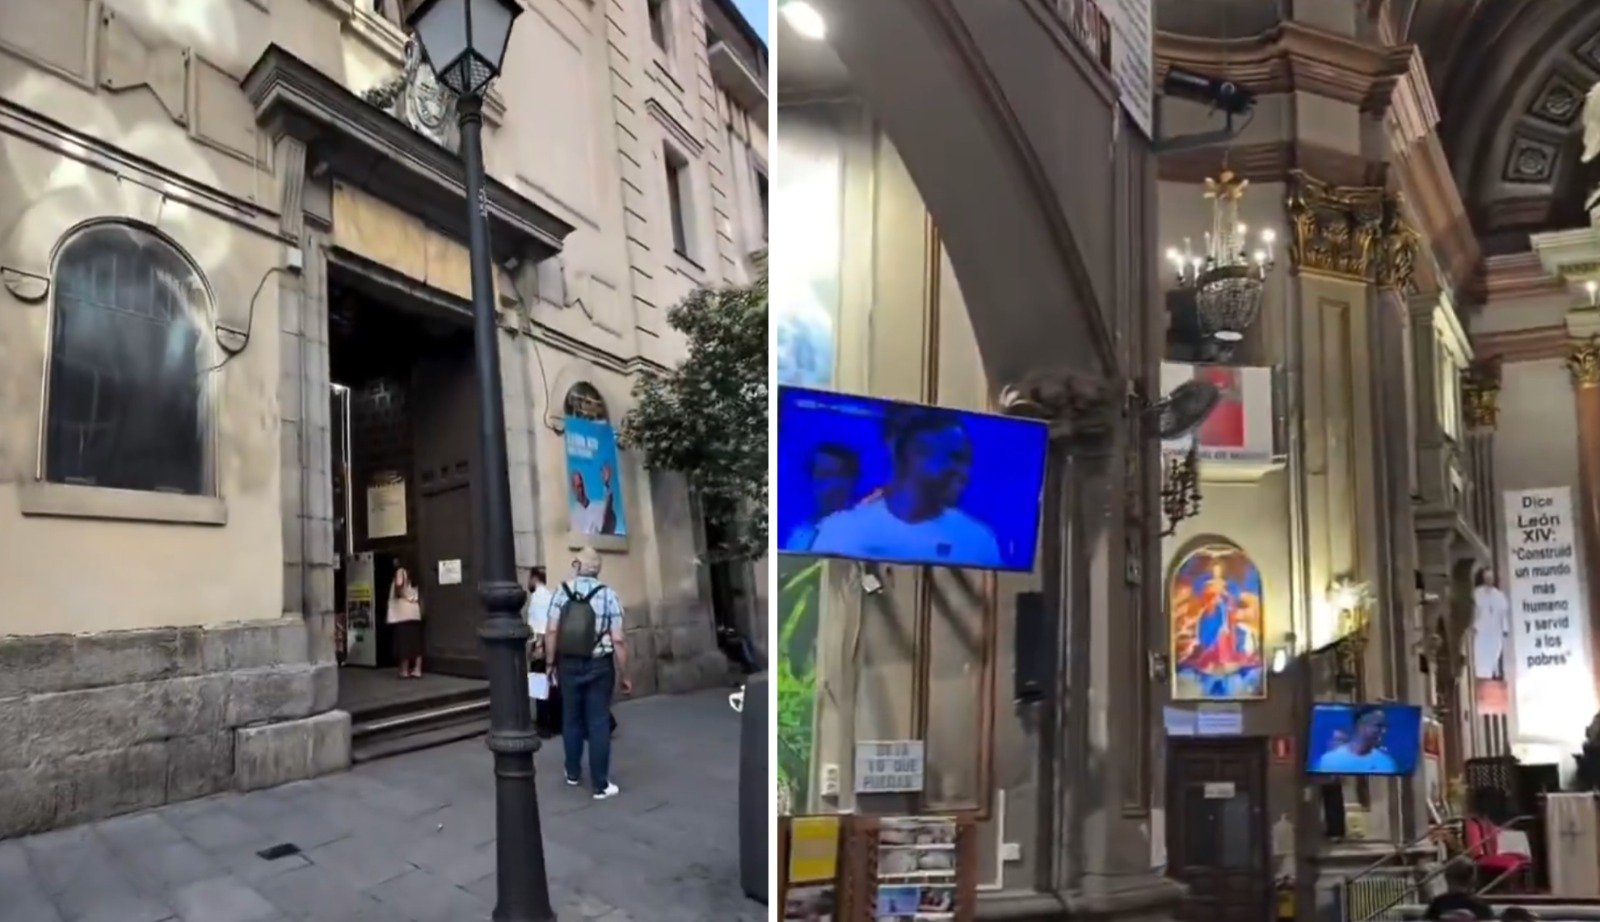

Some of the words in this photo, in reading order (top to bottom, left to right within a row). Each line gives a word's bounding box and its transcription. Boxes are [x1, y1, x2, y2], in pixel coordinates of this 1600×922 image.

[1522, 496, 1553, 508] Dice
[1518, 513, 1560, 529] León
[1523, 529, 1556, 542] XIV:
[1515, 566, 1530, 578] un
[1532, 564, 1571, 577] mundo
[1522, 599, 1569, 613] humano
[1524, 619, 1532, 633] y
[1534, 615, 1570, 629] servid
[1535, 637, 1542, 648] a
[1544, 634, 1562, 648] los
[893, 758, 918, 772] QUE
